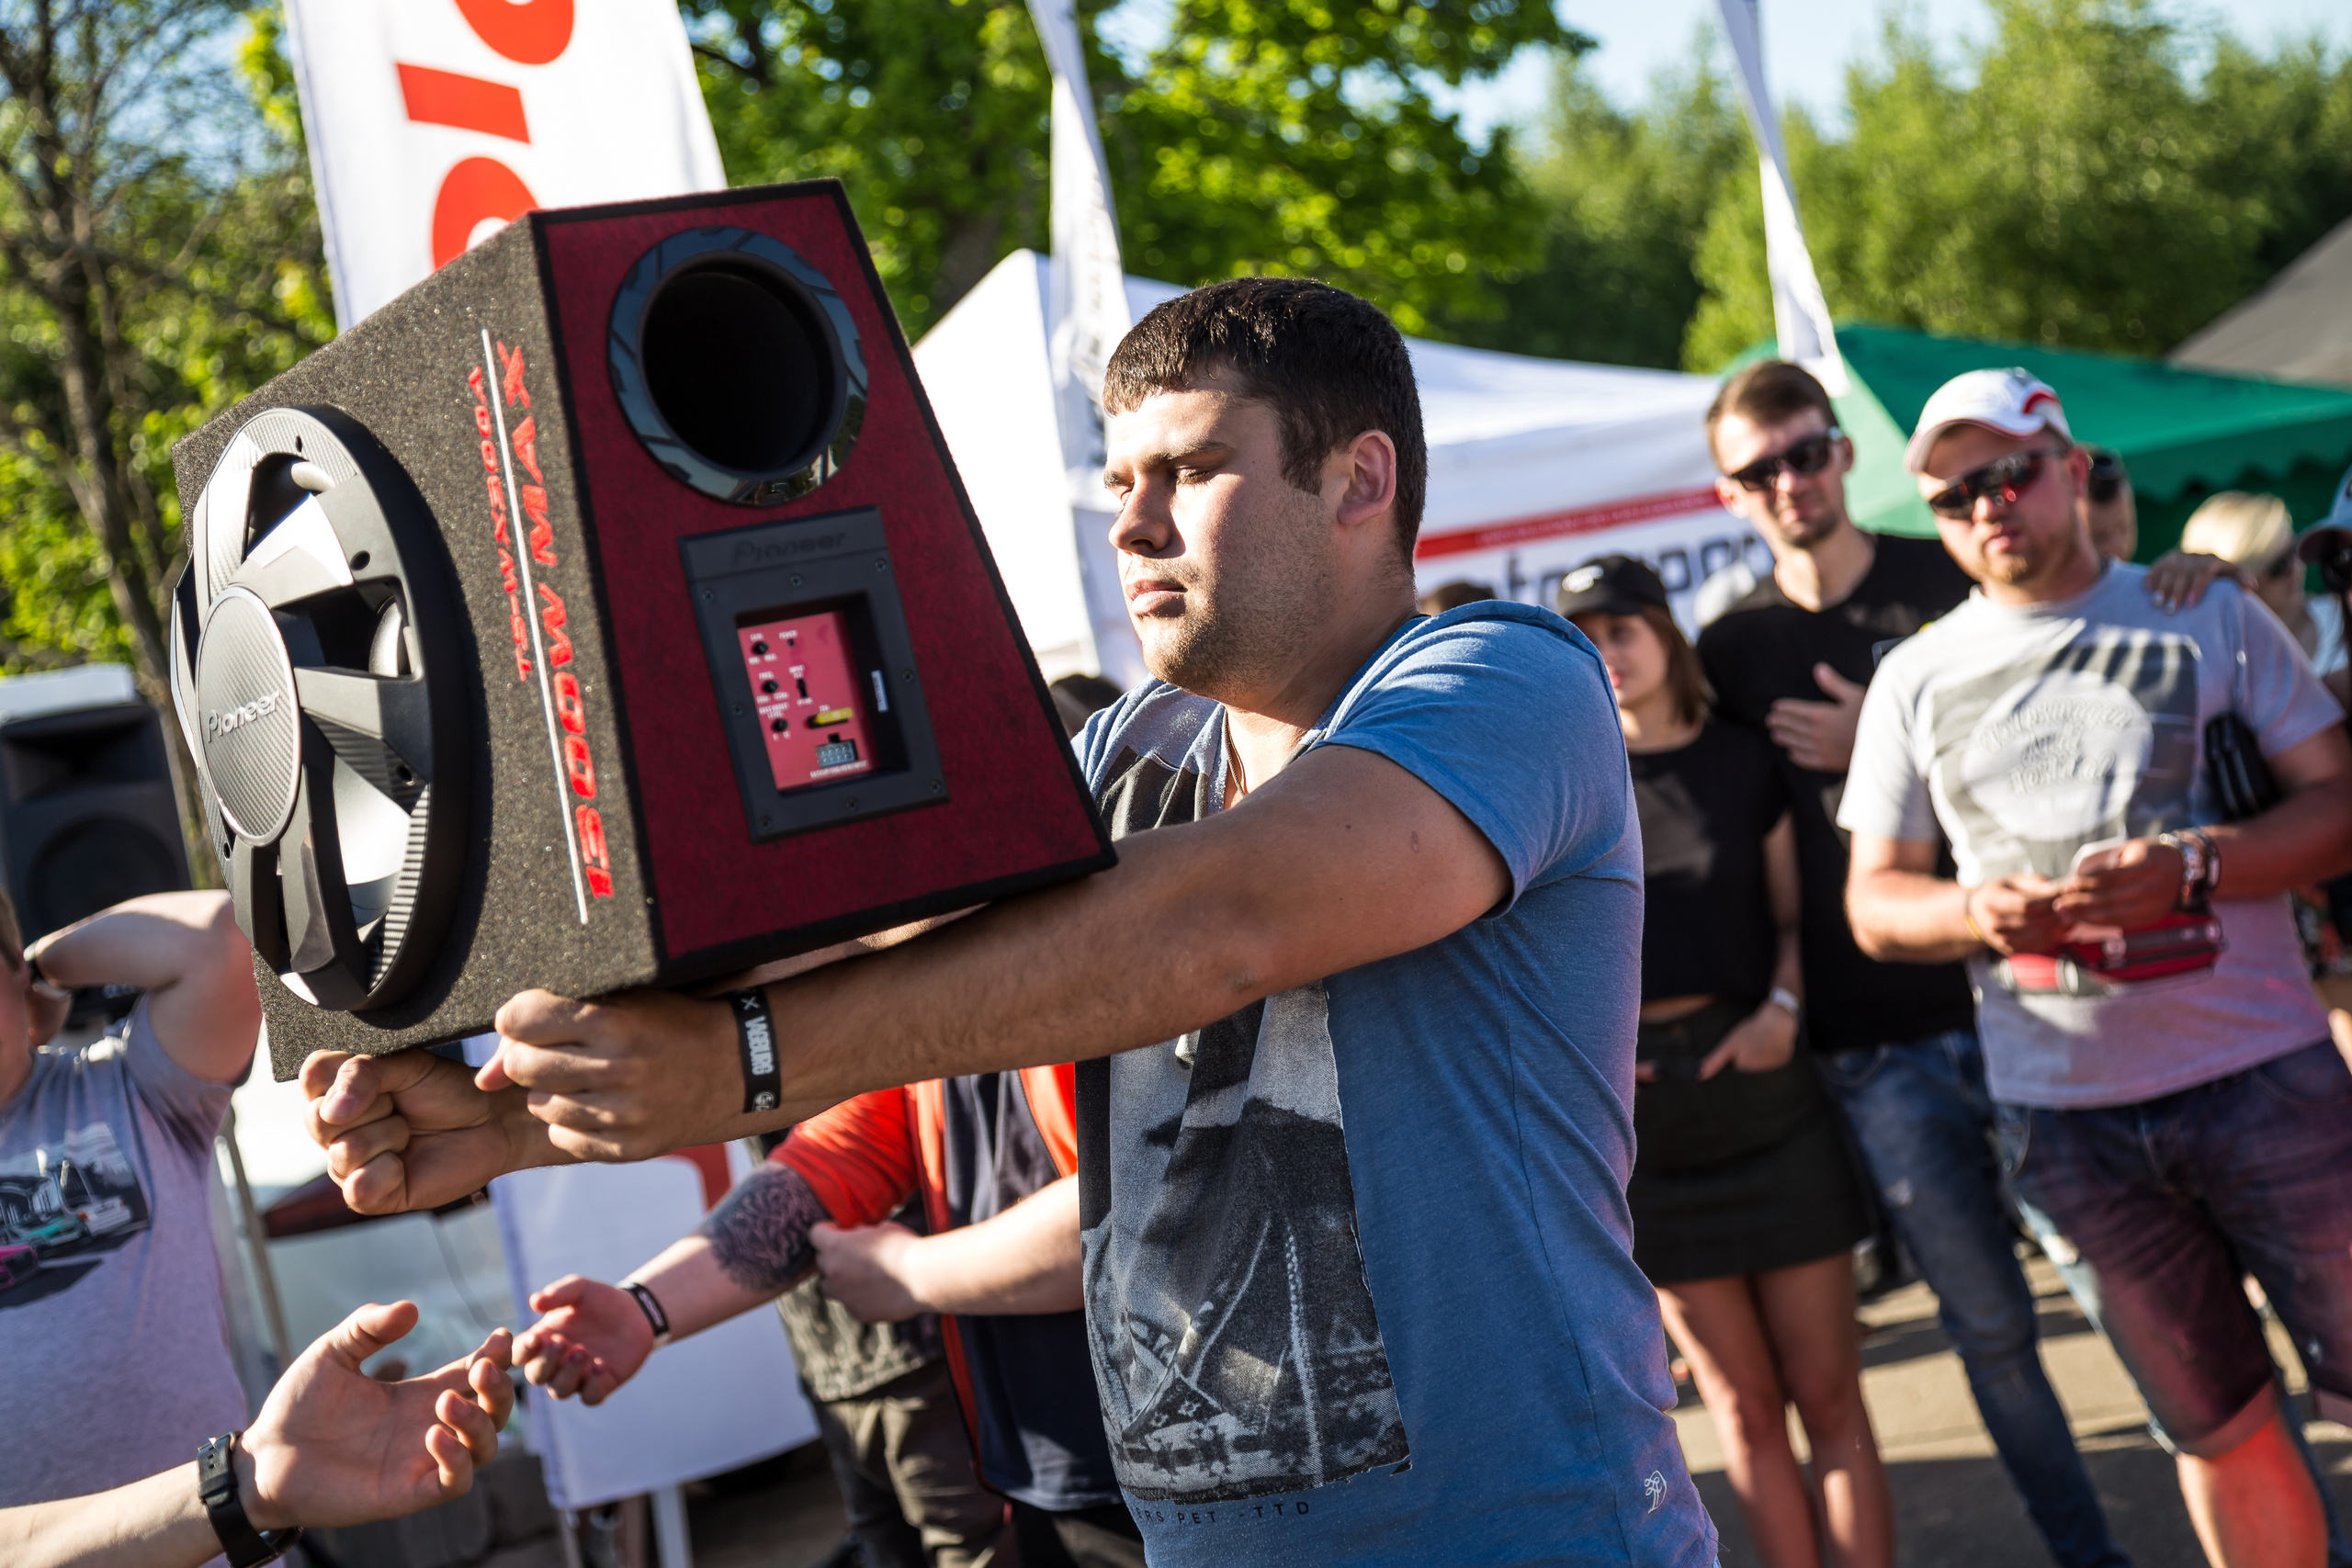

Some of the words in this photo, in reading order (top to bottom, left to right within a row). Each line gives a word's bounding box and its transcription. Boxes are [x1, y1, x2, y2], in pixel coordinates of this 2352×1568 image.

[498, 341, 557, 566] MAX
[469, 367, 531, 681] TS-WX300A
[734, 533, 844, 563] Pioneer
[207, 691, 280, 743] Pioneer
[538, 582, 614, 898] 1300W
[745, 1015, 775, 1076] VAGBURG
[1177, 1511, 1216, 1524] PET
